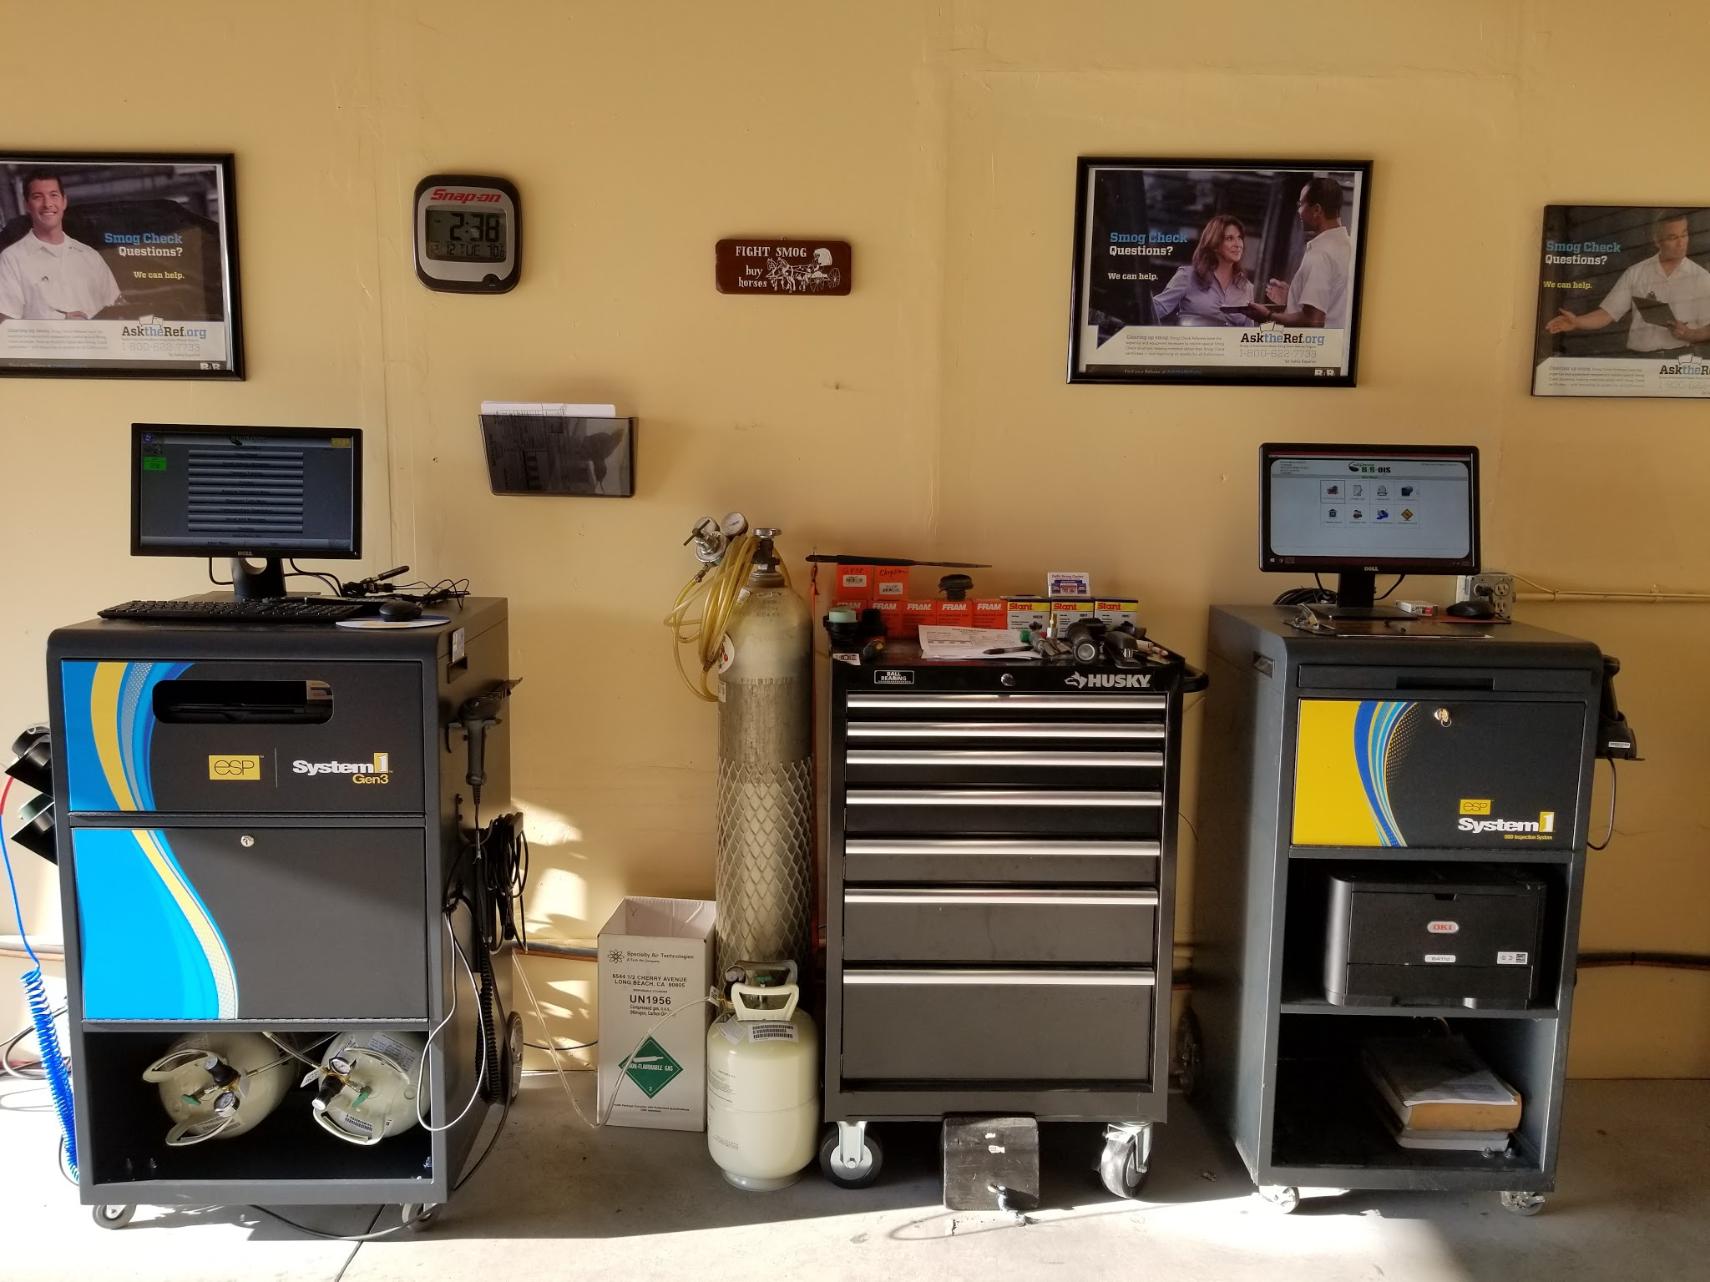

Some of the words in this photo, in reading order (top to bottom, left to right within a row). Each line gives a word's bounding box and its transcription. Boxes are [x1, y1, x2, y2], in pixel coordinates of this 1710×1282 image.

[430, 189, 502, 204] Snap-on
[449, 213, 499, 242] 2:38
[104, 233, 140, 245] Smog
[143, 233, 183, 244] Check
[1110, 232, 1146, 245] Smog
[1149, 232, 1188, 243] Check
[735, 246, 771, 257] FIGHT
[775, 247, 807, 258] SMOG
[1109, 246, 1174, 257] Questions?
[1545, 240, 1581, 253] Smog
[1583, 241, 1621, 253] Check
[118, 247, 183, 258] Questions?
[1545, 254, 1608, 265] Questions?
[133, 271, 148, 279] We
[164, 271, 185, 280] help.
[745, 264, 763, 280] buy
[1107, 272, 1121, 280] We
[1138, 272, 1159, 281] help.
[738, 276, 768, 288] horses
[1573, 281, 1593, 290] help.
[121, 325, 207, 340] AsktheRef.org
[1240, 332, 1325, 345] AsktheRef.org
[1659, 364, 1710, 375] AsktheR
[872, 602, 897, 610] FRAM
[907, 603, 932, 611] FRAM
[942, 603, 968, 611] FRAM
[977, 603, 1002, 611] FRAM
[1087, 674, 1151, 688] HUSKY
[352, 774, 389, 785] Gen3
[629, 994, 672, 1005] UN1956
